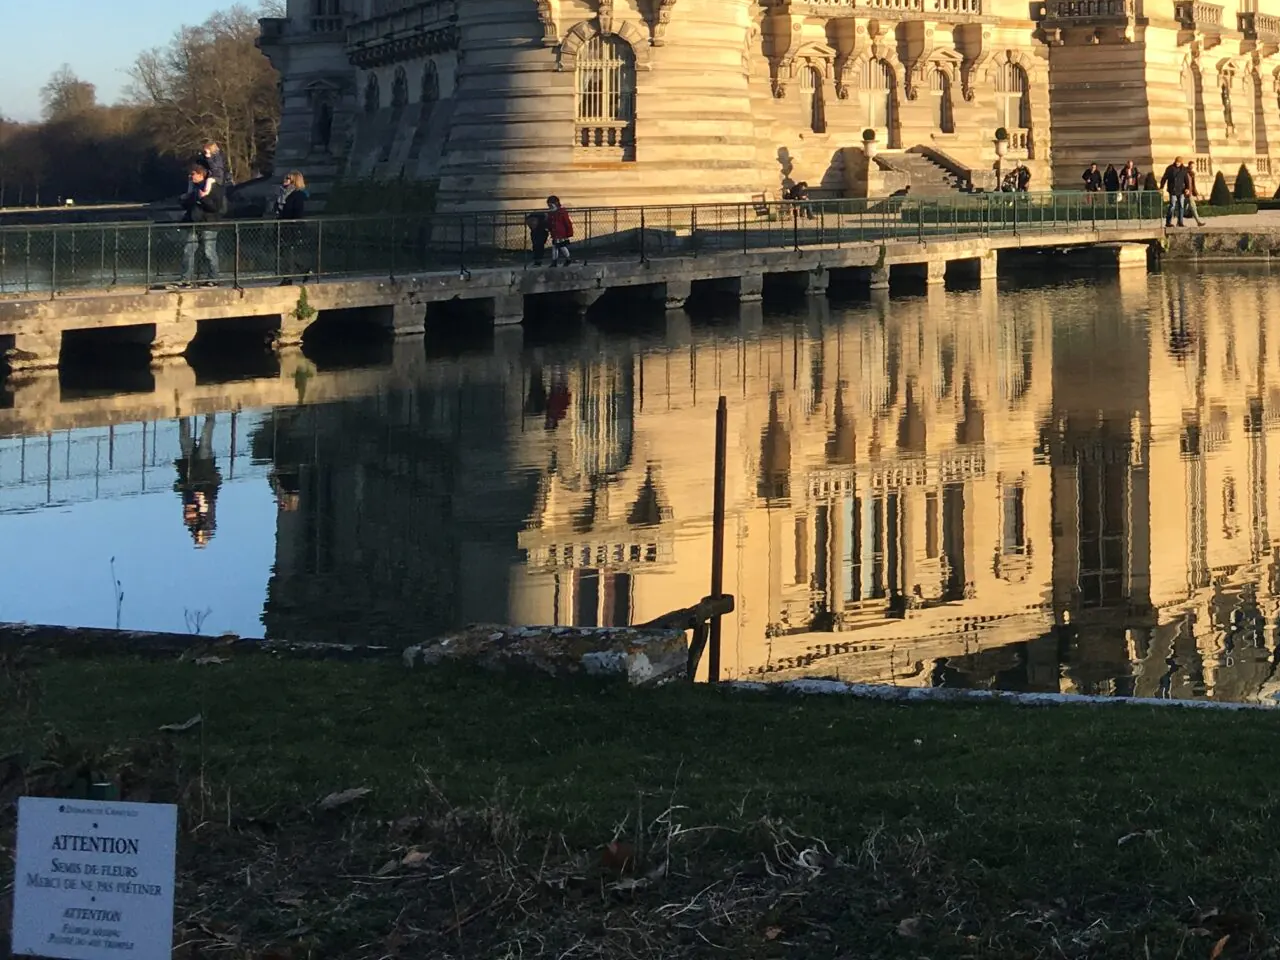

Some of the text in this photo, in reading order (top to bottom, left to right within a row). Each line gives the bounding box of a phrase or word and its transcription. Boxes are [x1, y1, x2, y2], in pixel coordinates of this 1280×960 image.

[52, 835, 139, 855] ATTENTION
[84, 864, 99, 875] DE
[101, 865, 138, 877] FLEURS
[64, 878, 77, 889] DE
[81, 880, 93, 891] NE
[96, 880, 114, 892] PAS
[63, 907, 123, 922] ATTENTION
